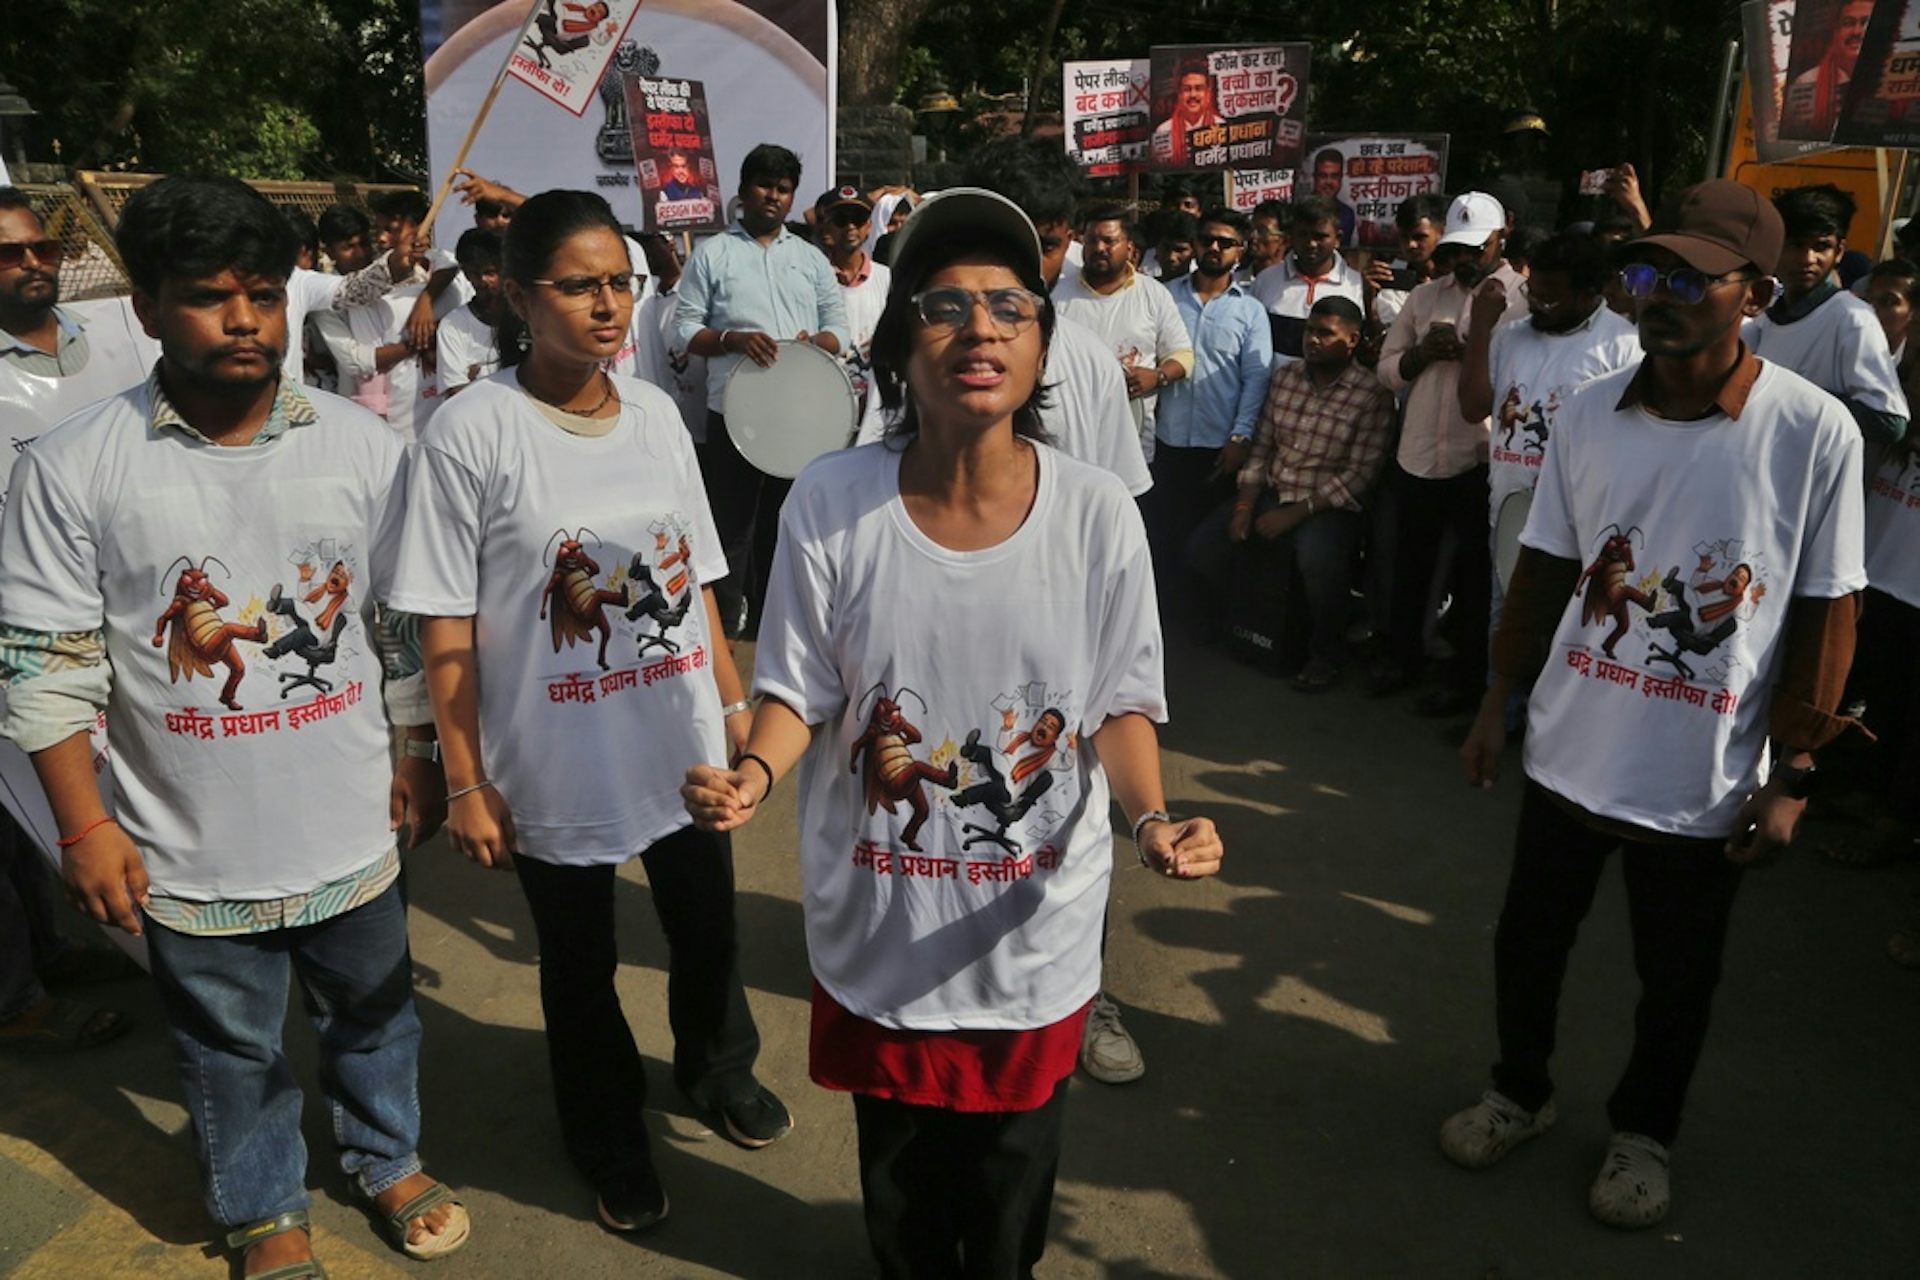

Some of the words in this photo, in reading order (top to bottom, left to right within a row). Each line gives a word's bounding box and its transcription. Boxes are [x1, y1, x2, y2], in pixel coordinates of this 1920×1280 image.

[1214, 53, 1238, 70] कौन
[1241, 53, 1260, 67] कर
[1263, 50, 1281, 65] रहा
[552, 79, 570, 97] दो!
[1075, 70, 1100, 89] पेपर
[1104, 67, 1129, 87] लीक
[1253, 71, 1272, 87] का
[1075, 90, 1098, 112] बंद
[1223, 89, 1277, 115] नुकसान
[1229, 119, 1274, 142] प्रधान!
[1229, 139, 1272, 161] प्रधान!
[1235, 169, 1259, 187] पेपर
[1350, 176, 1412, 201] इस्तीफा
[1236, 189, 1259, 207] बंद
[659, 203, 690, 218] RESIGN
[600, 669, 638, 697] प्रधान
[642, 655, 691, 686] इस्तीफा
[1595, 660, 1640, 689] प्रधान
[1642, 674, 1708, 707] इस्तीफा
[1711, 688, 1738, 715] दो!
[220, 711, 280, 738] प्रधान
[287, 693, 346, 730] इस्तीफा
[899, 854, 960, 880] प्रधान
